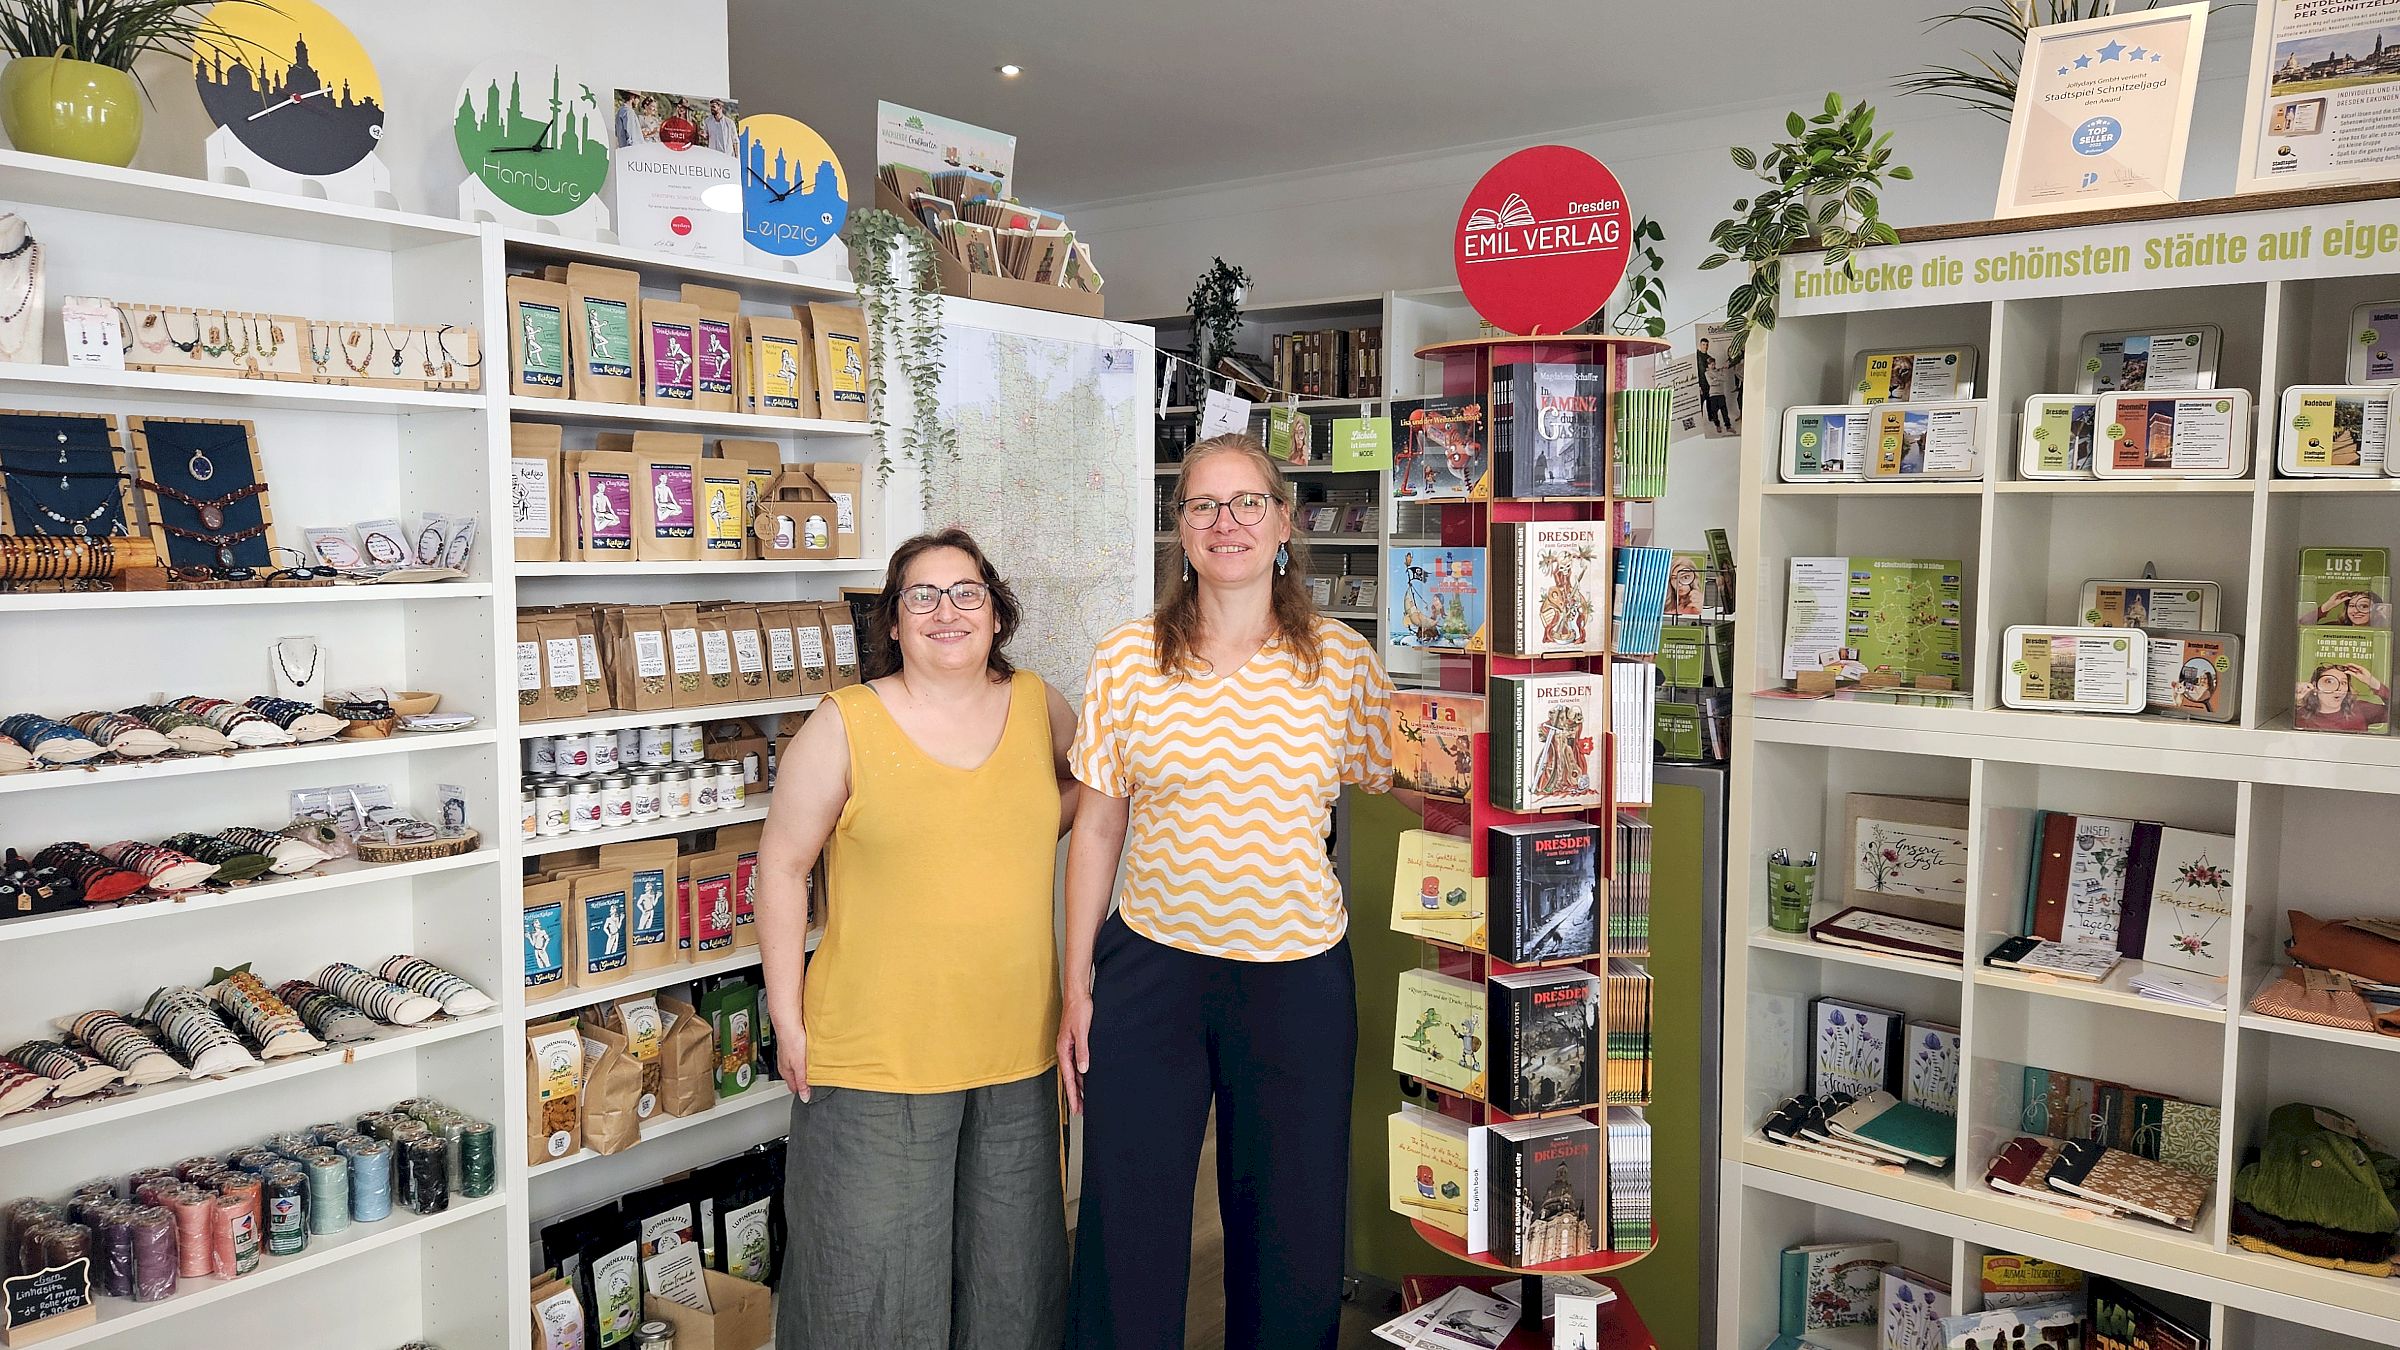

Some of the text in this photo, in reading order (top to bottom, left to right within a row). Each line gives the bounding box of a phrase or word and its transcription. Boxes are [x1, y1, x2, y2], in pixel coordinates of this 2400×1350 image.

[2294, 10, 2317, 20] PER
[2097, 76, 2120, 85] GmbH
[2120, 72, 2147, 81] verleiht
[2044, 78, 2168, 102] Stadtspiel Schnitzeljagd
[2337, 88, 2375, 98] INDIVIDUELL
[2099, 96, 2122, 105] Award
[2337, 94, 2399, 107] DRESDEN ERKUNDEN
[2087, 127, 2108, 136] TOP
[2079, 134, 2114, 145] SELLER
[628, 161, 731, 179] KUNDENLIEBLING
[482, 157, 581, 202] Hamburg
[1568, 199, 1620, 215] Dresden
[746, 210, 818, 246] Leipzig
[1465, 220, 1620, 257] EMIL VERLAG
[1793, 220, 2400, 299] Entdecke die schönsten Städte auf eige
[1871, 360, 1887, 370] Zoo
[1540, 373, 1574, 382] Magdalena
[1870, 370, 1887, 378] Leipzig
[1541, 386, 1549, 395] In
[1540, 396, 1597, 412] KAMENZ
[2118, 403, 2147, 412] Chemnitz
[1538, 406, 1595, 441] GASSEN
[1538, 531, 1595, 542] DRESDEN
[2326, 559, 2361, 572] LUST
[1537, 686, 1592, 698] DRESDEN
[1583, 742, 1589, 750] 2
[2080, 825, 2111, 836] UNSER
[1535, 836, 1591, 852] DRESDEN
[1533, 985, 1589, 1004] DRESDEN
[1534, 1143, 1590, 1164] DRESDEN
[647, 1215, 688, 1237] LUPINENKAFFEE
[598, 1256, 636, 1280] LUPINENKAFFEE
[16, 1283, 63, 1301] Linhasita
[40, 1300, 60, 1310] Rolle
